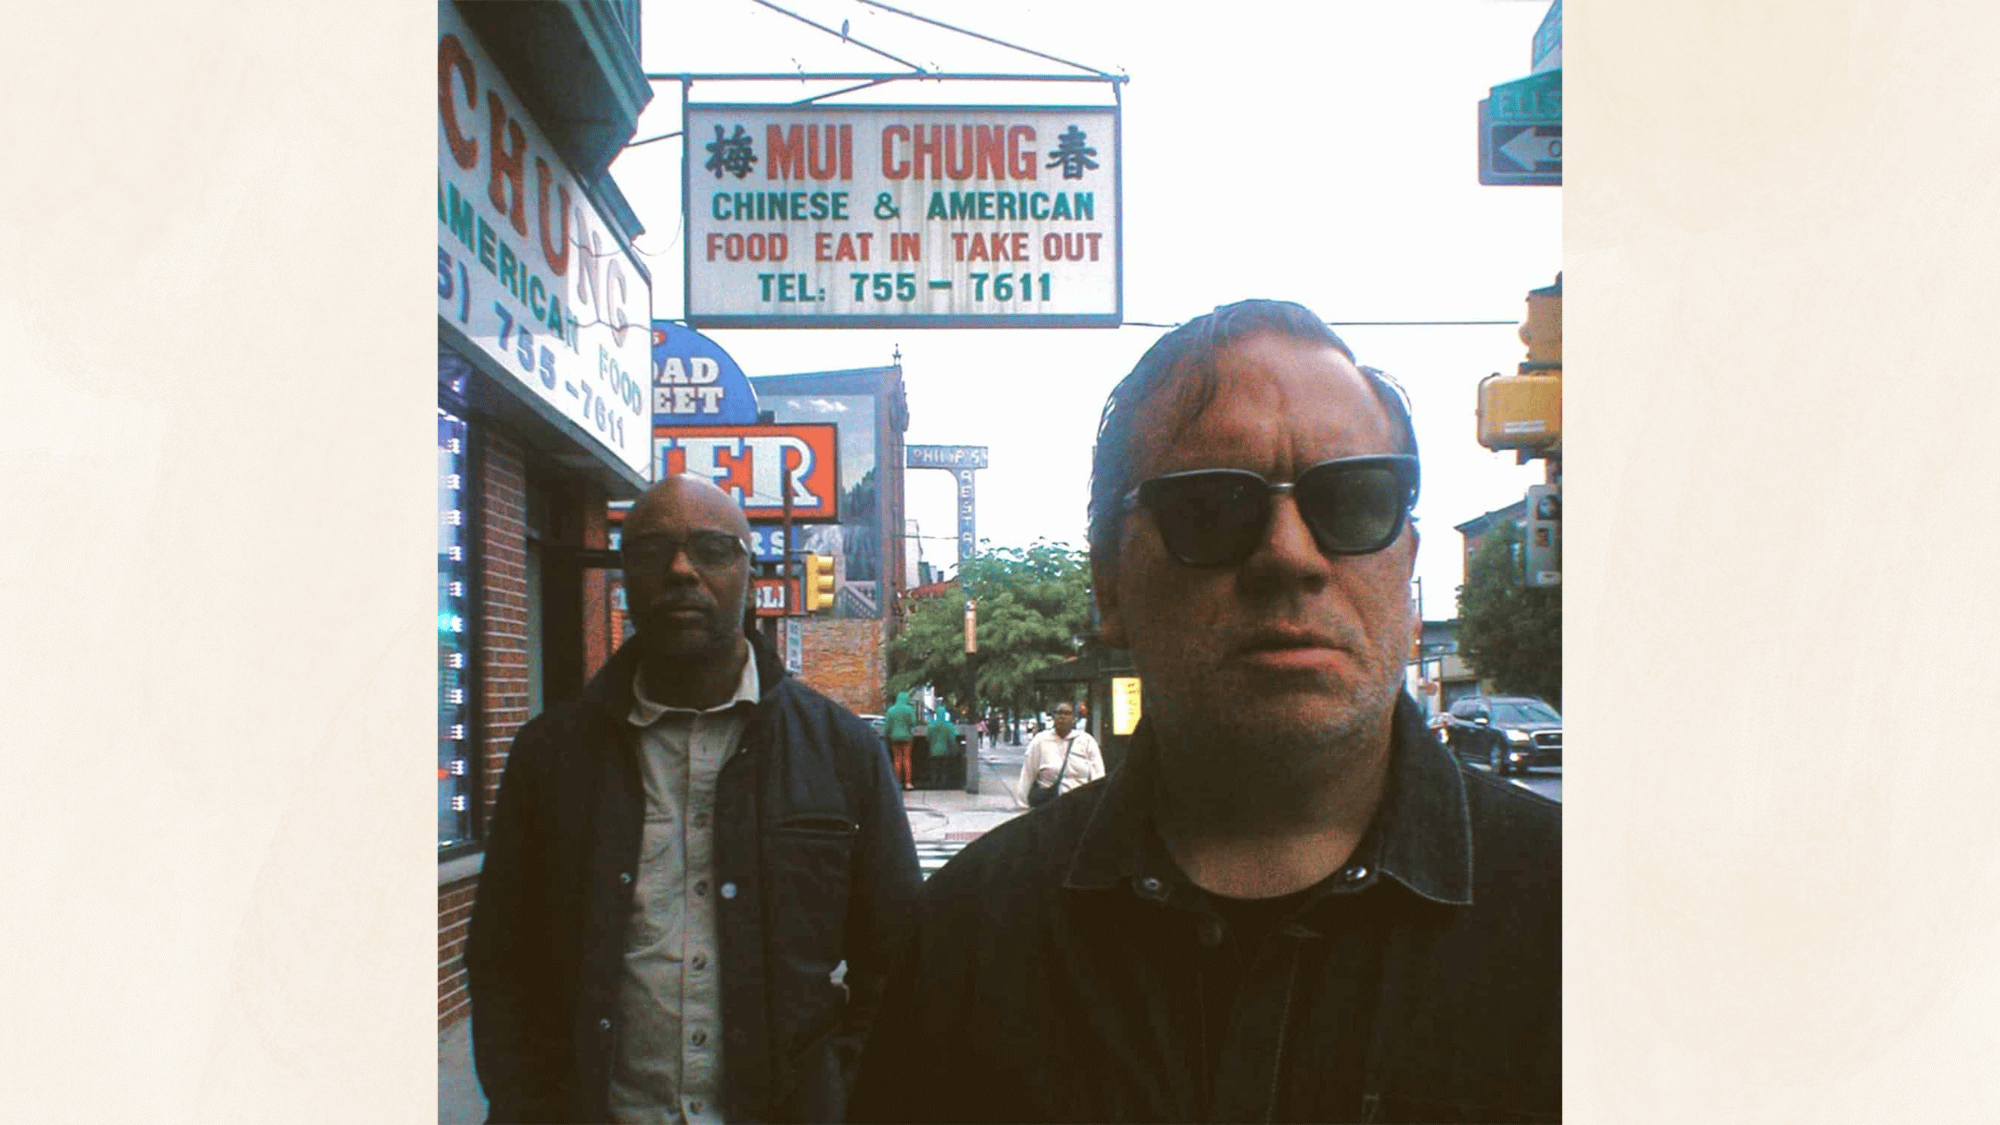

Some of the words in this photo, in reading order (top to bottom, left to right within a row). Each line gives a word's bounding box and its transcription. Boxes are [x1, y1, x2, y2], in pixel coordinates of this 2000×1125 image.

[705, 124, 758, 179] 梅
[766, 124, 853, 180] MUI
[881, 125, 1037, 180] CHUNG
[1045, 124, 1100, 179] 春
[438, 34, 628, 348] CHUNG
[712, 192, 849, 221] CHINESE
[874, 193, 900, 220] &
[927, 191, 1095, 221] AMERICAN
[707, 233, 788, 262] FOOD
[815, 233, 874, 262] EAT
[890, 233, 921, 262] IN
[951, 232, 1030, 262] TAKE
[1043, 232, 1103, 262] OUT
[758, 273, 826, 302] TEL:
[599, 344, 643, 417] FOOD
